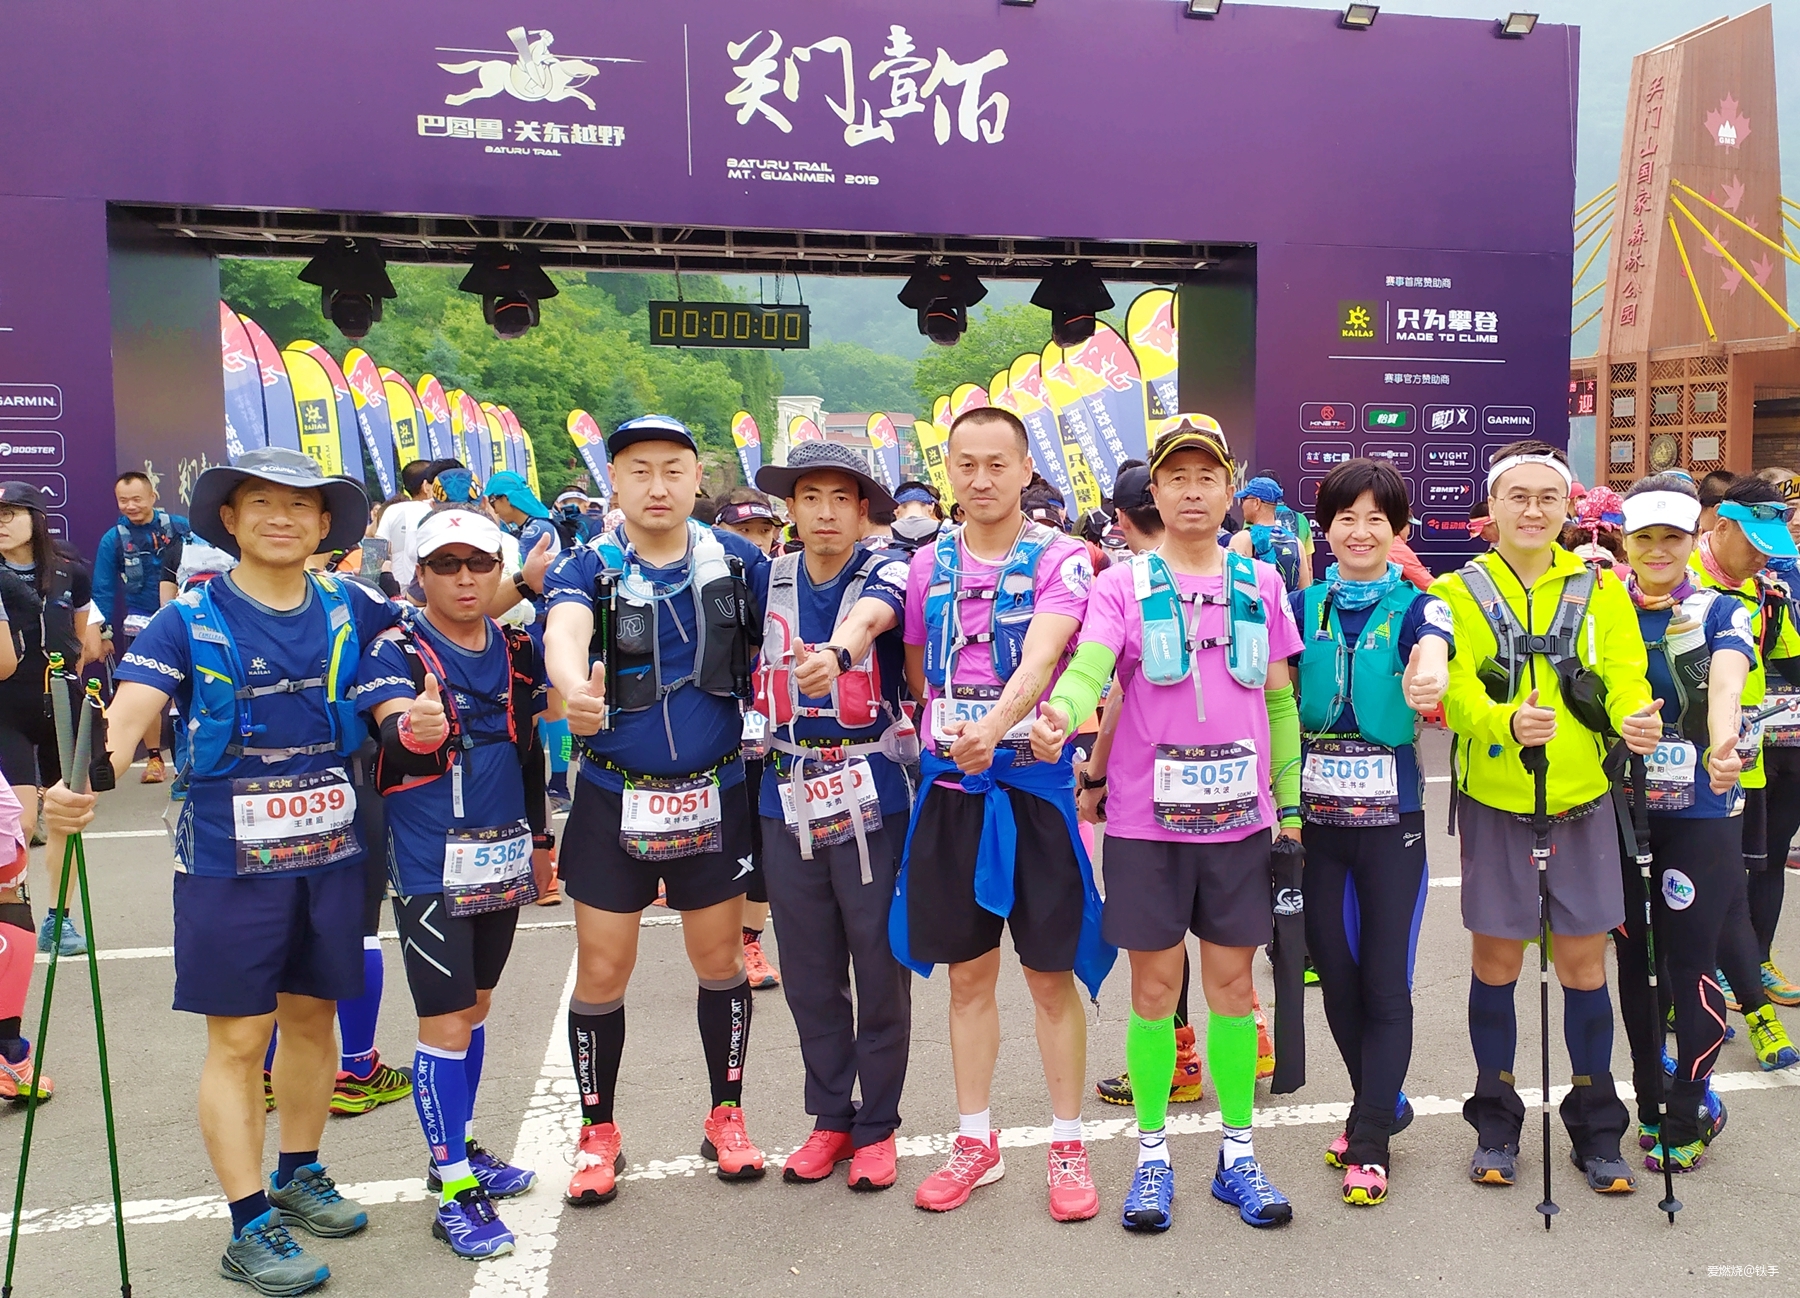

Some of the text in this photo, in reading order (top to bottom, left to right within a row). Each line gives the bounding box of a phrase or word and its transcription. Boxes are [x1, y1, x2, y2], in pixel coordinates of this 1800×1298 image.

[1718, 136, 1736, 146] GMS
[484, 145, 562, 158] BATURU TRAIL
[726, 158, 833, 172] BATURU TRAIL
[727, 169, 880, 186] MT. GUANMEN 2019
[1619, 75, 1665, 327] 关门山国家森林公园
[1385, 275, 1452, 290] 赛事首席赞助商
[658, 308, 802, 341] 00:00:00
[1396, 308, 1499, 333] 只为攀登
[1341, 329, 1374, 338] KAILAS
[1395, 332, 1499, 344] MADE TO CLIMB
[1384, 372, 1450, 386] 赛事官方赞助商
[1487, 415, 1531, 425] GARMIN
[1438, 452, 1469, 460] VIGHT
[1751, 531, 1774, 551] OUTDOOR
[955, 702, 996, 723] 50
[1181, 760, 1249, 786] 5057
[1321, 758, 1384, 780] 5061
[266, 788, 345, 819] 0039
[649, 789, 710, 816] 0051
[473, 838, 526, 867] 5362
